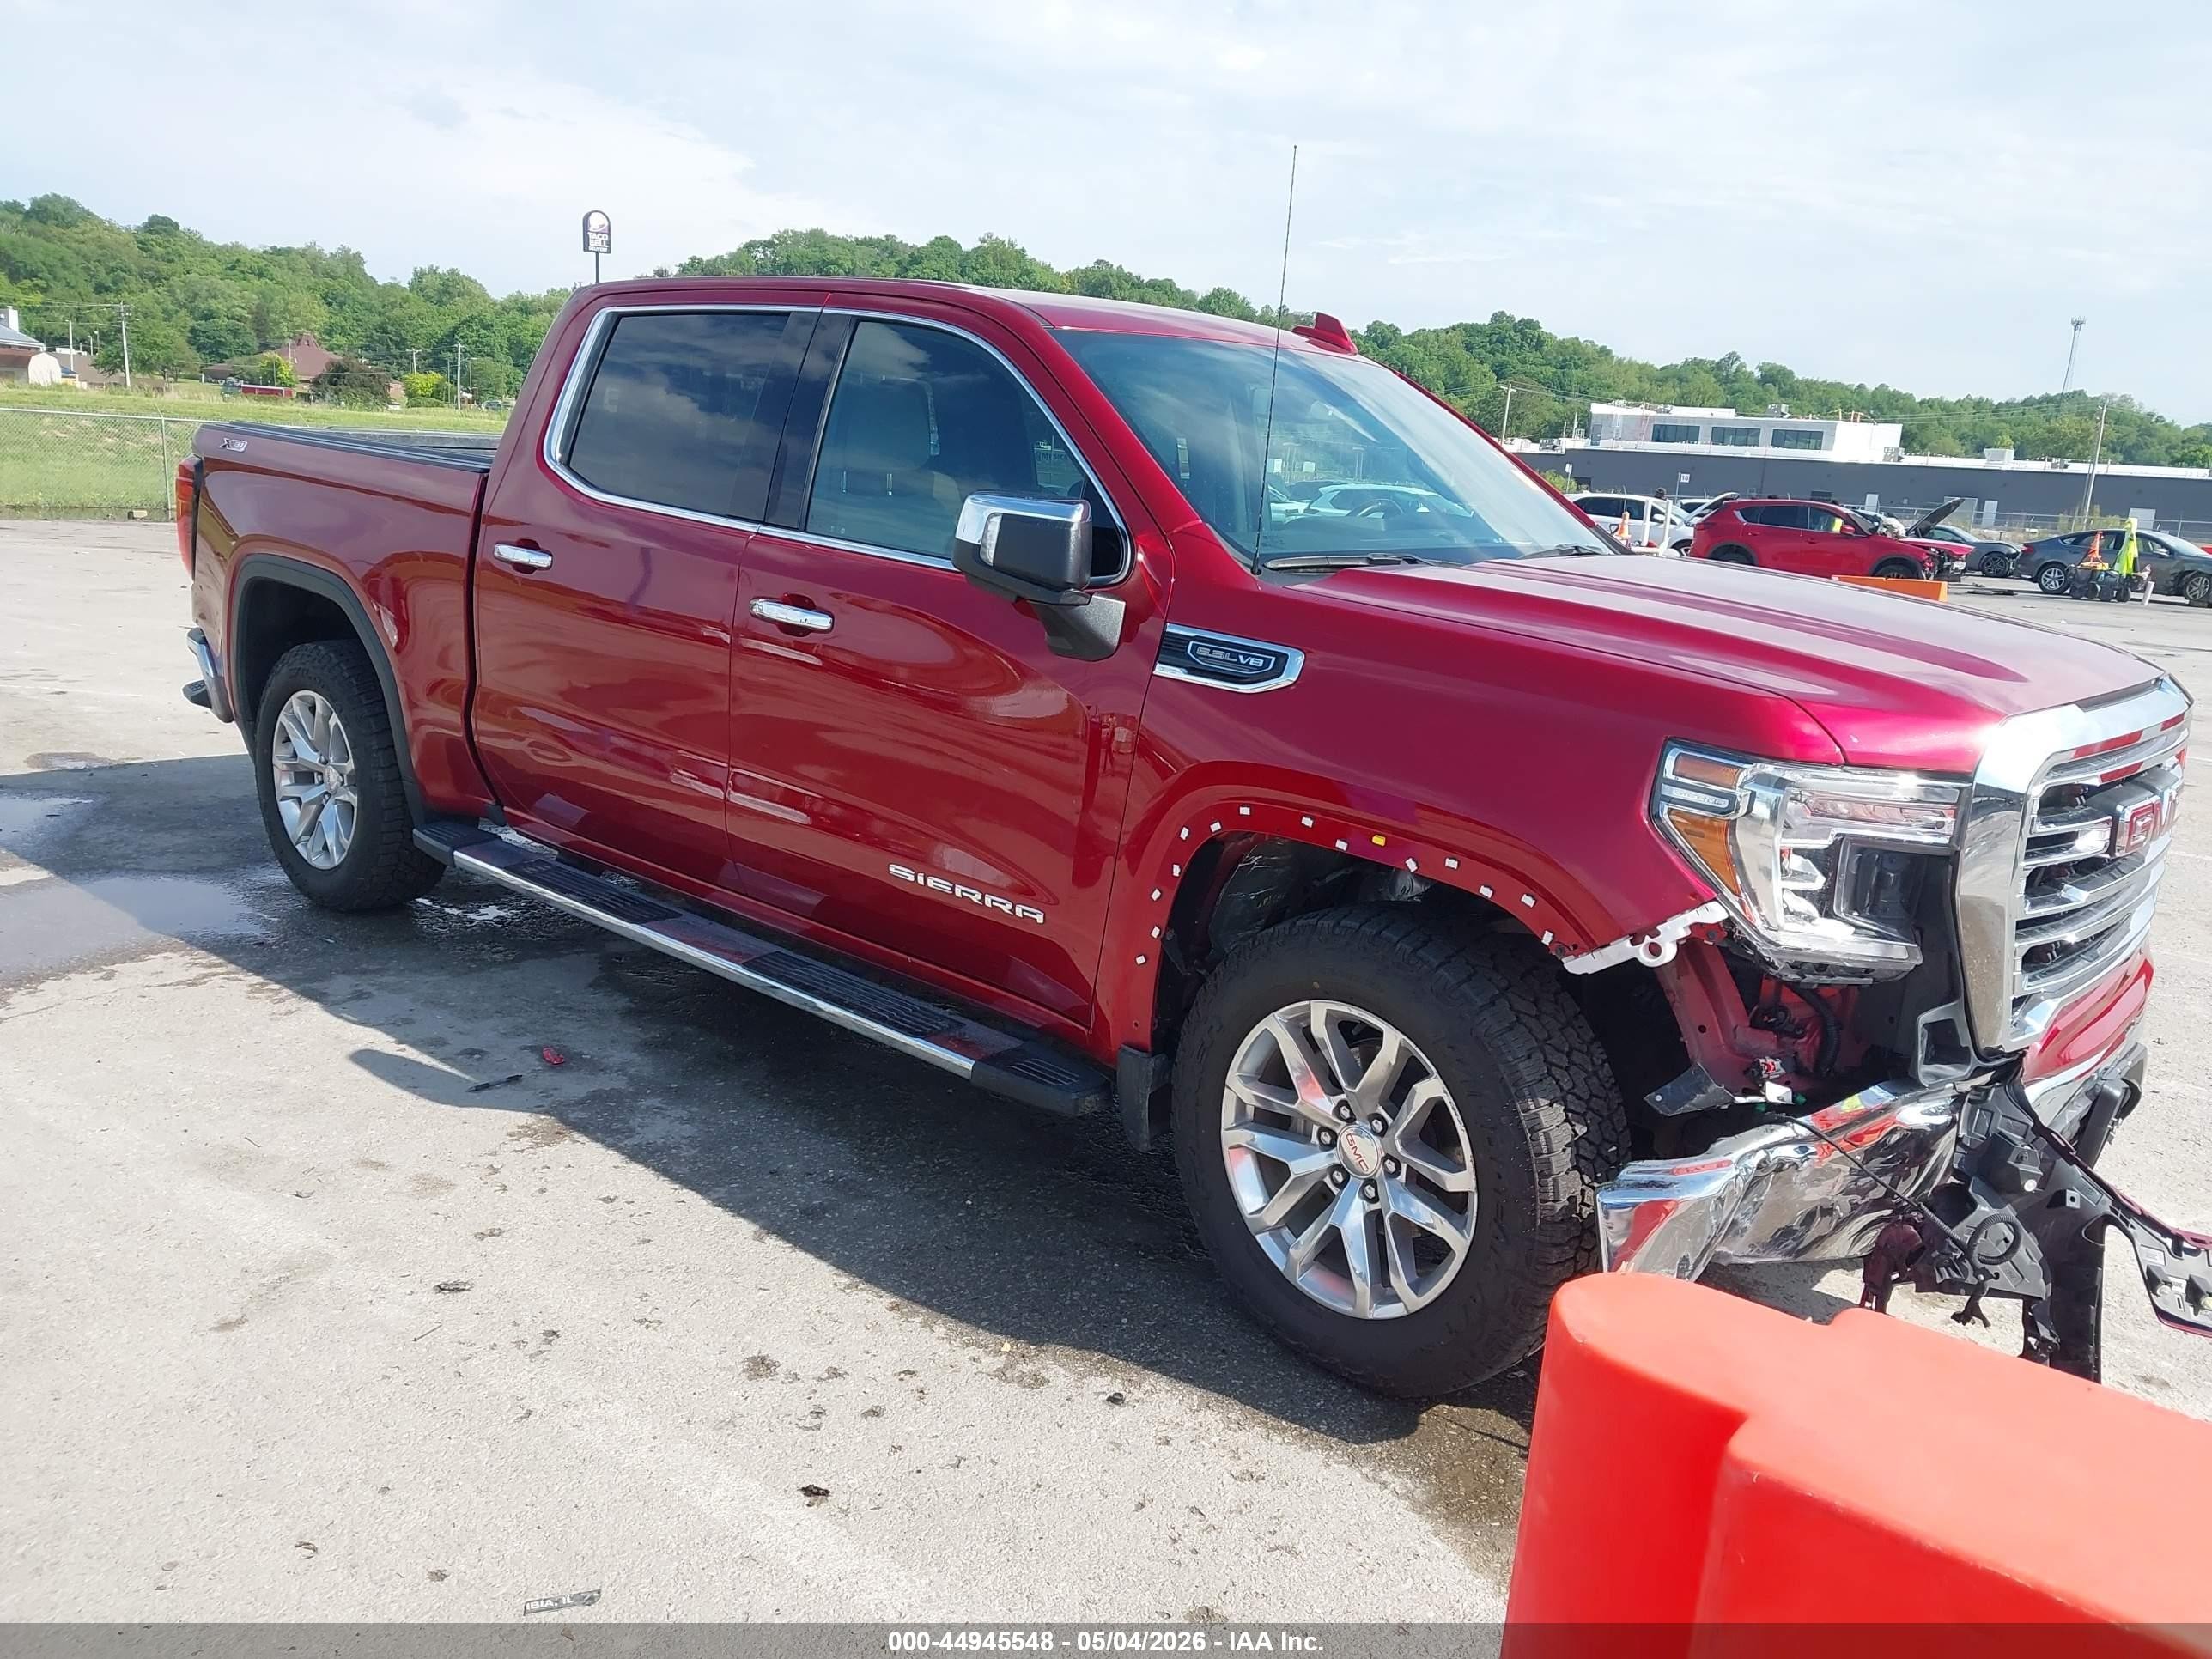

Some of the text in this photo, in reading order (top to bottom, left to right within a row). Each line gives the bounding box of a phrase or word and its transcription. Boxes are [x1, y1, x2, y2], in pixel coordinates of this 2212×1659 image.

[587, 232, 609, 241] TACO
[589, 239, 609, 248] BELL
[889, 864, 1044, 924] SIERRA
[1346, 1133, 1370, 1173] GMC
